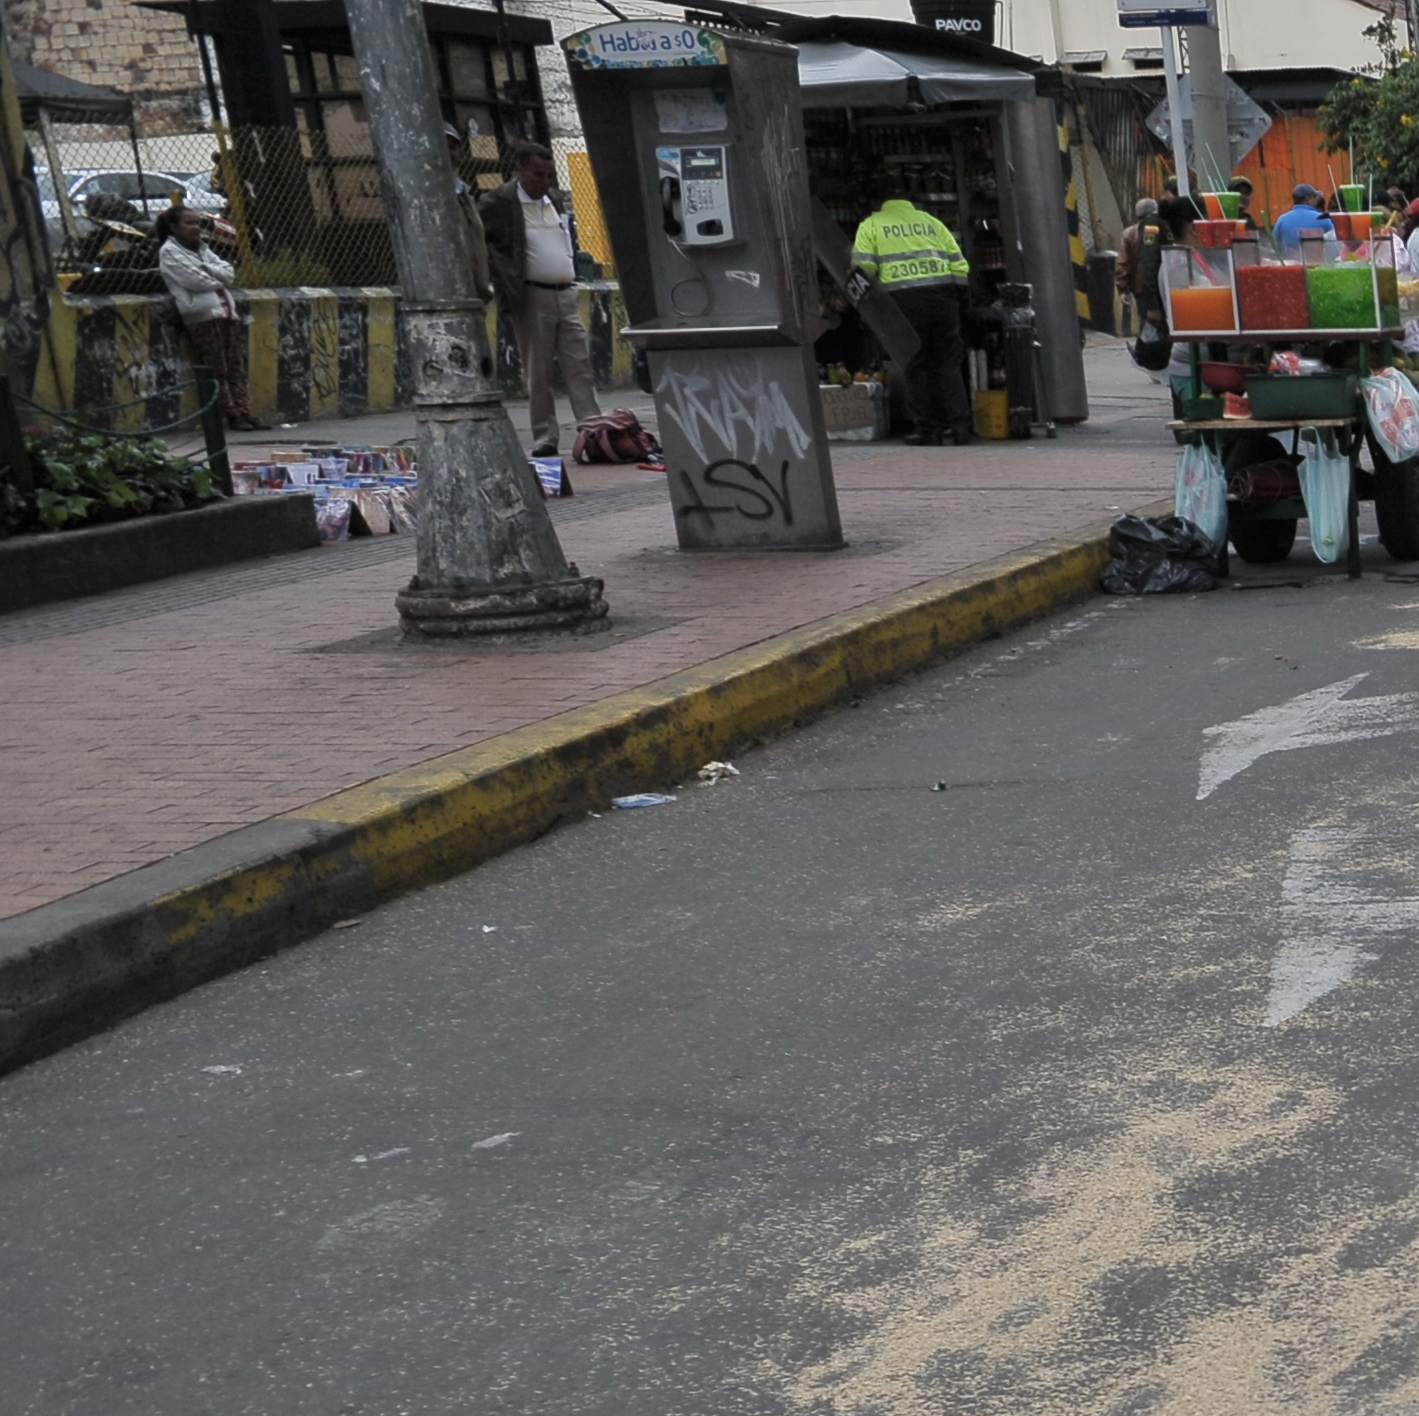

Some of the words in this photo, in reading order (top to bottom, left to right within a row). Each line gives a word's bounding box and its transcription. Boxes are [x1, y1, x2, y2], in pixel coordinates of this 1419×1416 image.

[935, 17, 982, 32] PAVCO
[660, 35, 672, 50] a
[675, 29, 695, 49] $0
[882, 222, 937, 239] POLICIA
